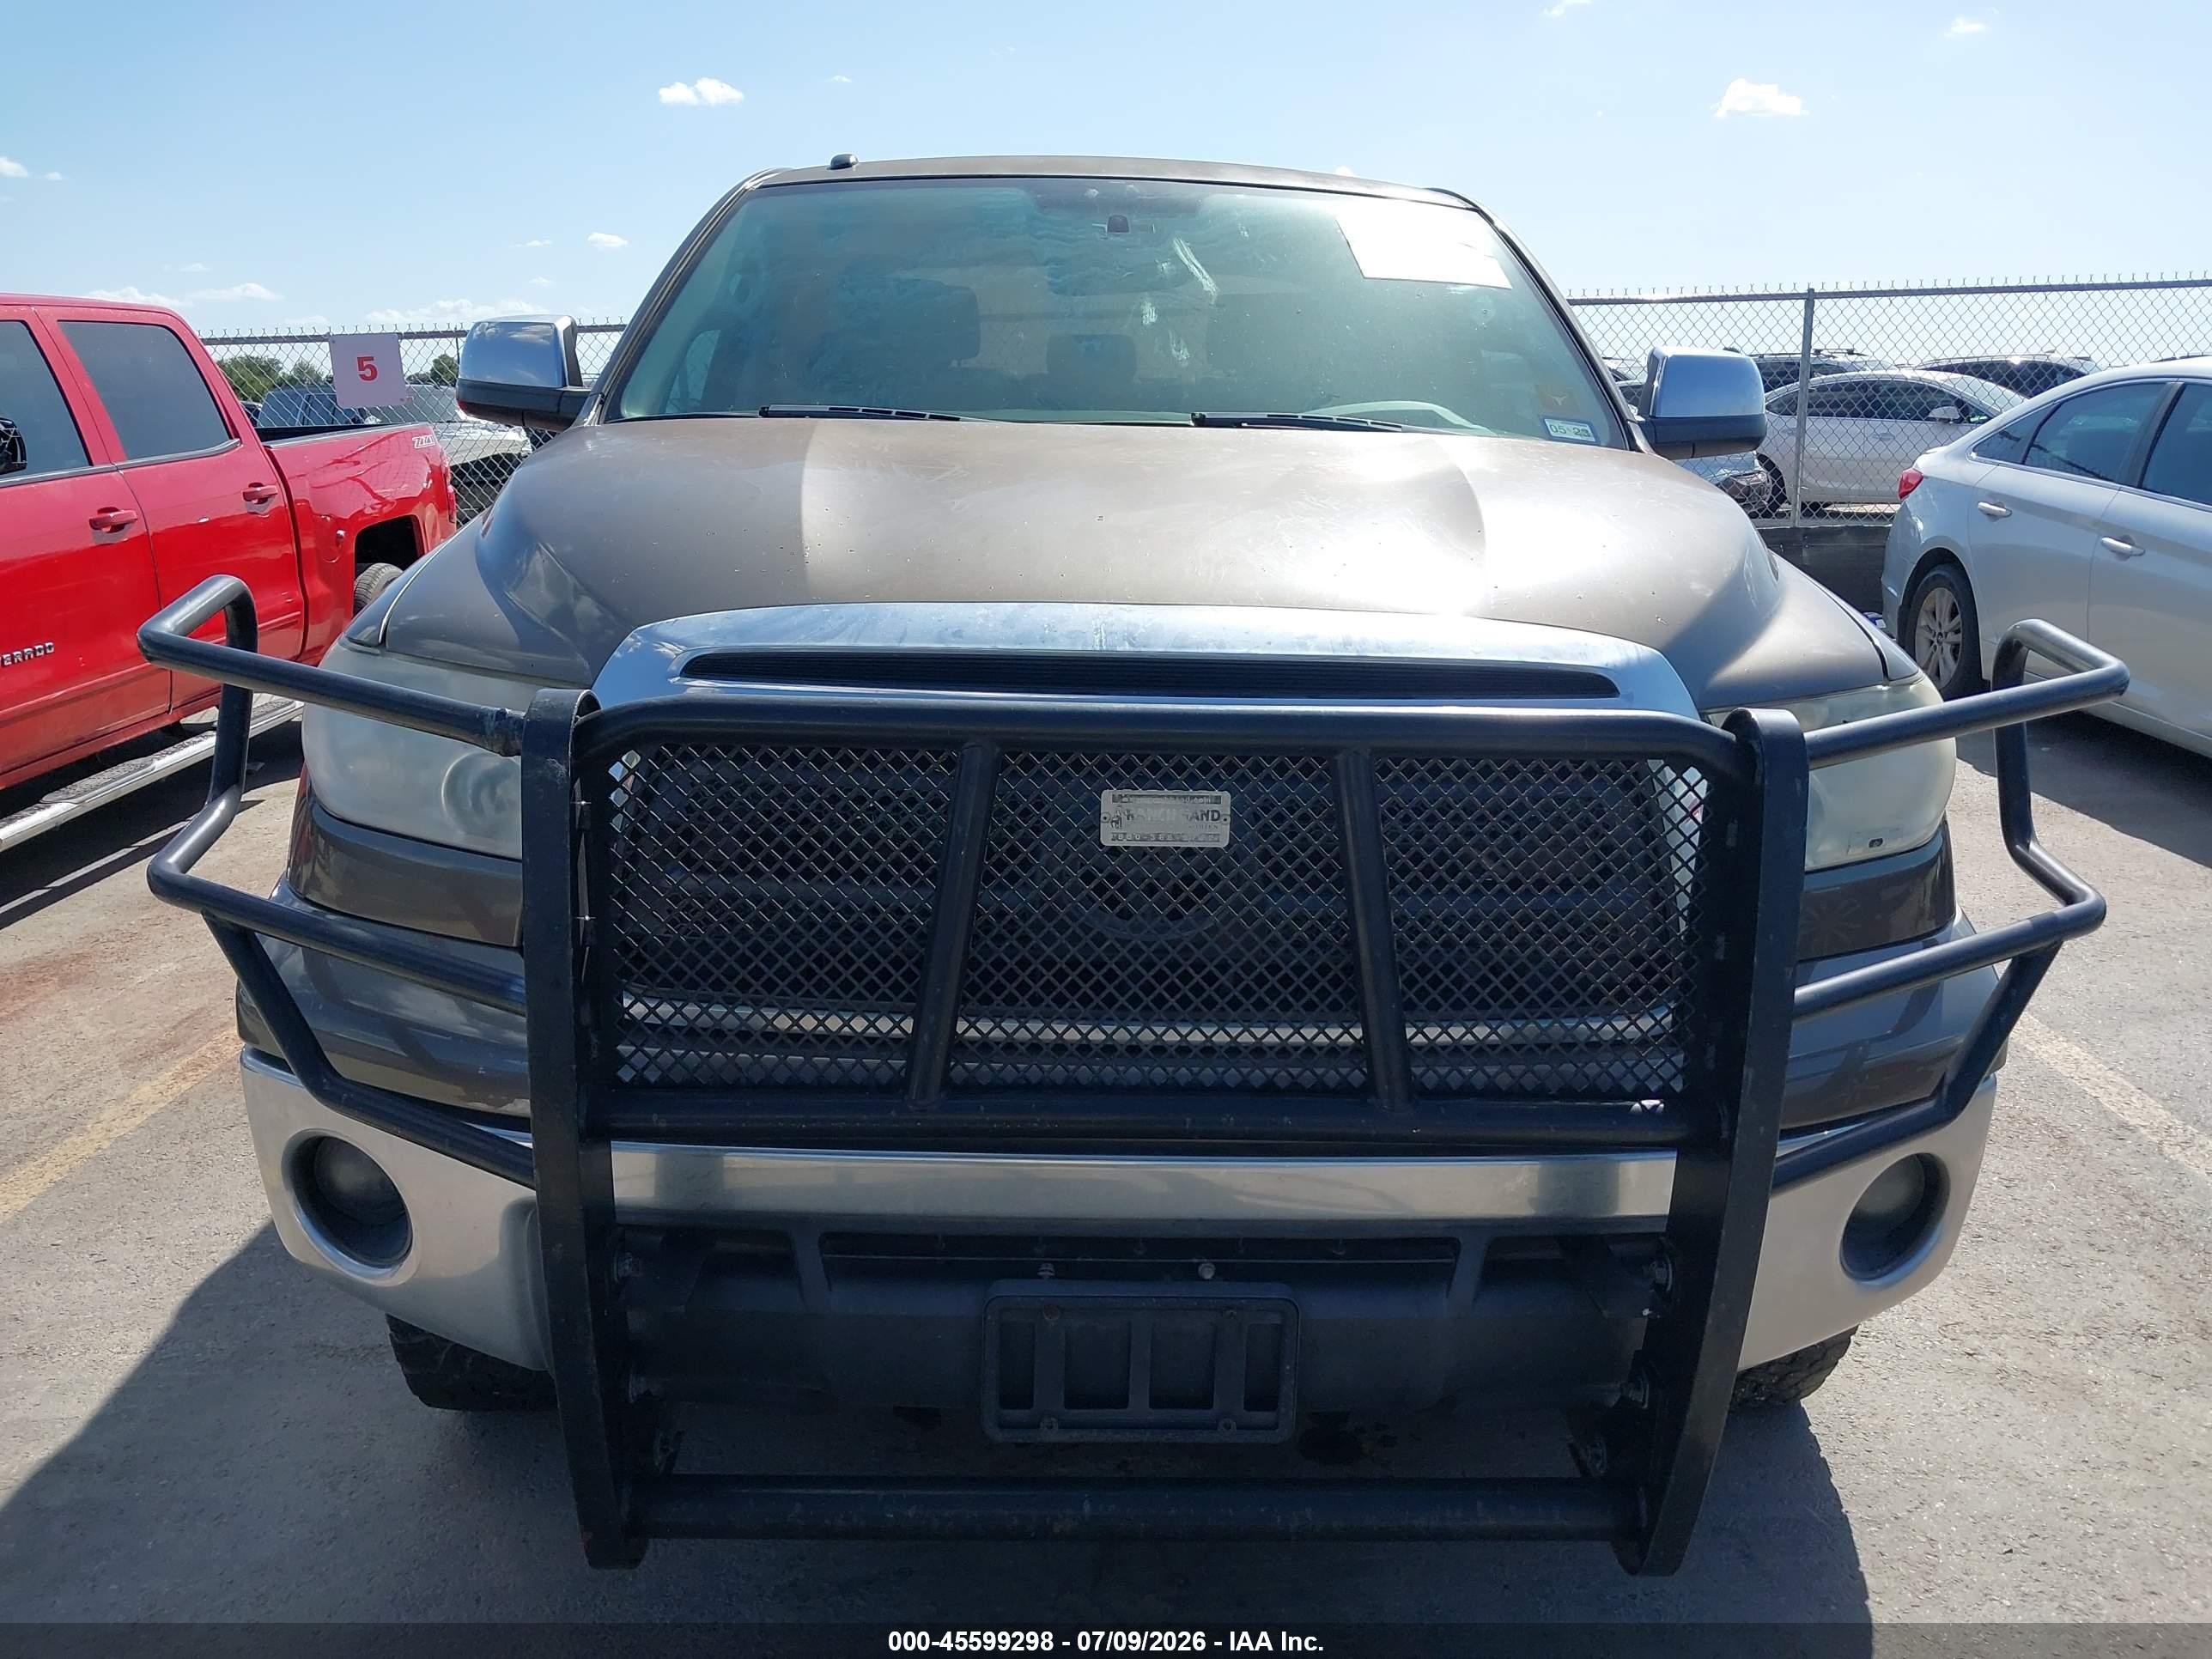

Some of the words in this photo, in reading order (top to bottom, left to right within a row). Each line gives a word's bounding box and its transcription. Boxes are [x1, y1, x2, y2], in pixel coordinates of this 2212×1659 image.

[356, 356, 378, 381] 5
[1549, 424, 1567, 434] 05
[0, 641, 55, 666] ERADO
